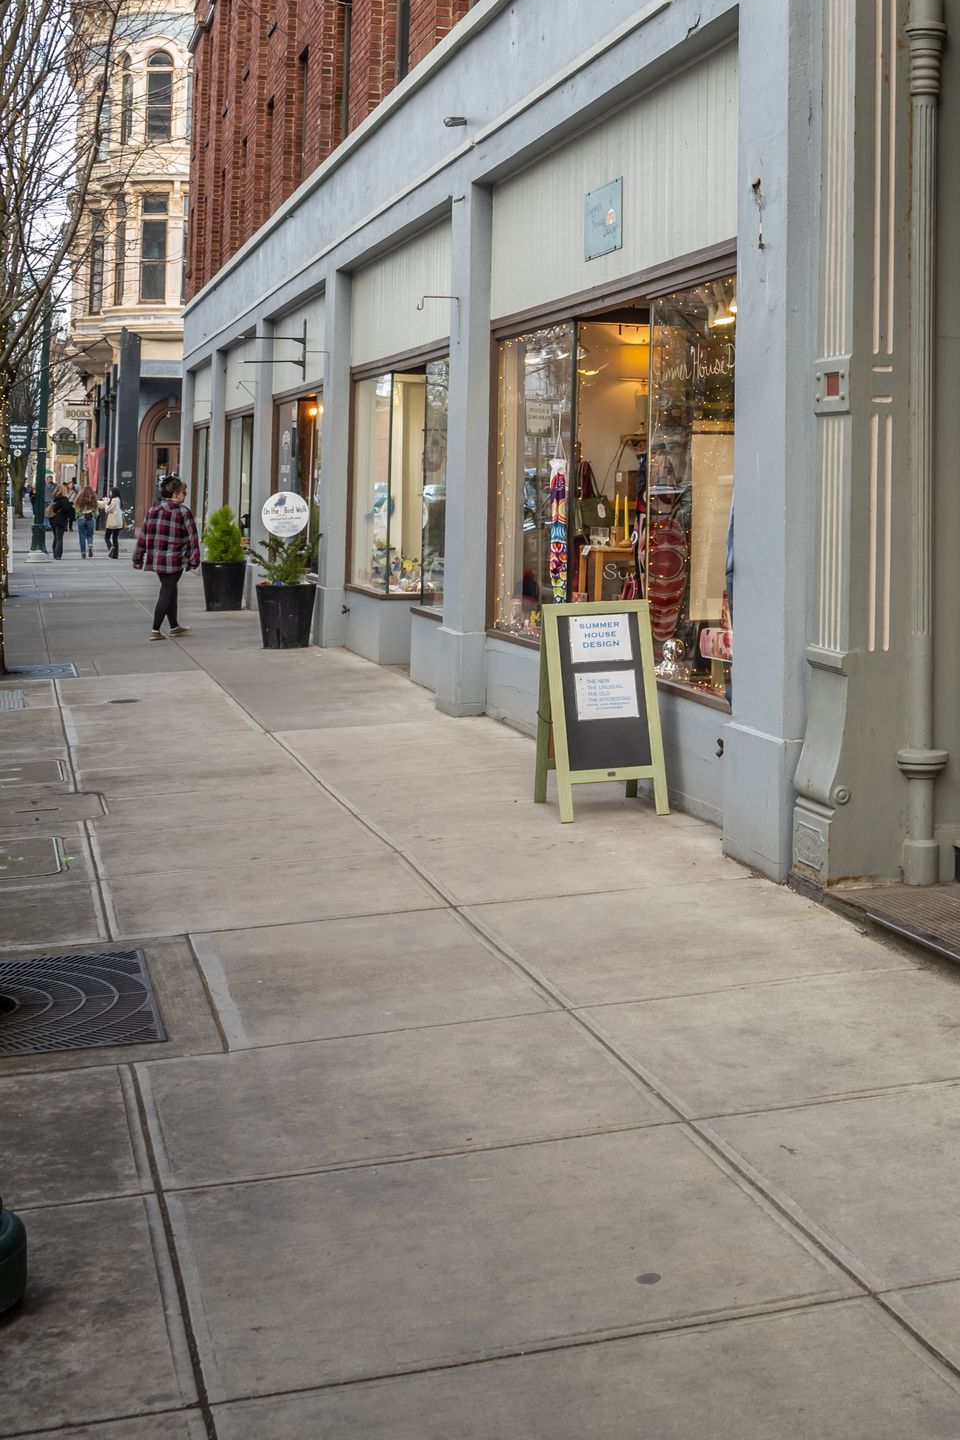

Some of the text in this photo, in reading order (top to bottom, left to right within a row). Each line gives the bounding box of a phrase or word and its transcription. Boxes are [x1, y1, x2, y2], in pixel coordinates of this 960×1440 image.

[65, 409, 91, 418] BOOKS
[295, 505, 307, 513] Walk
[579, 621, 620, 630] SUMMER
[584, 631, 617, 639] HOUSE
[582, 640, 620, 649] DESIGN
